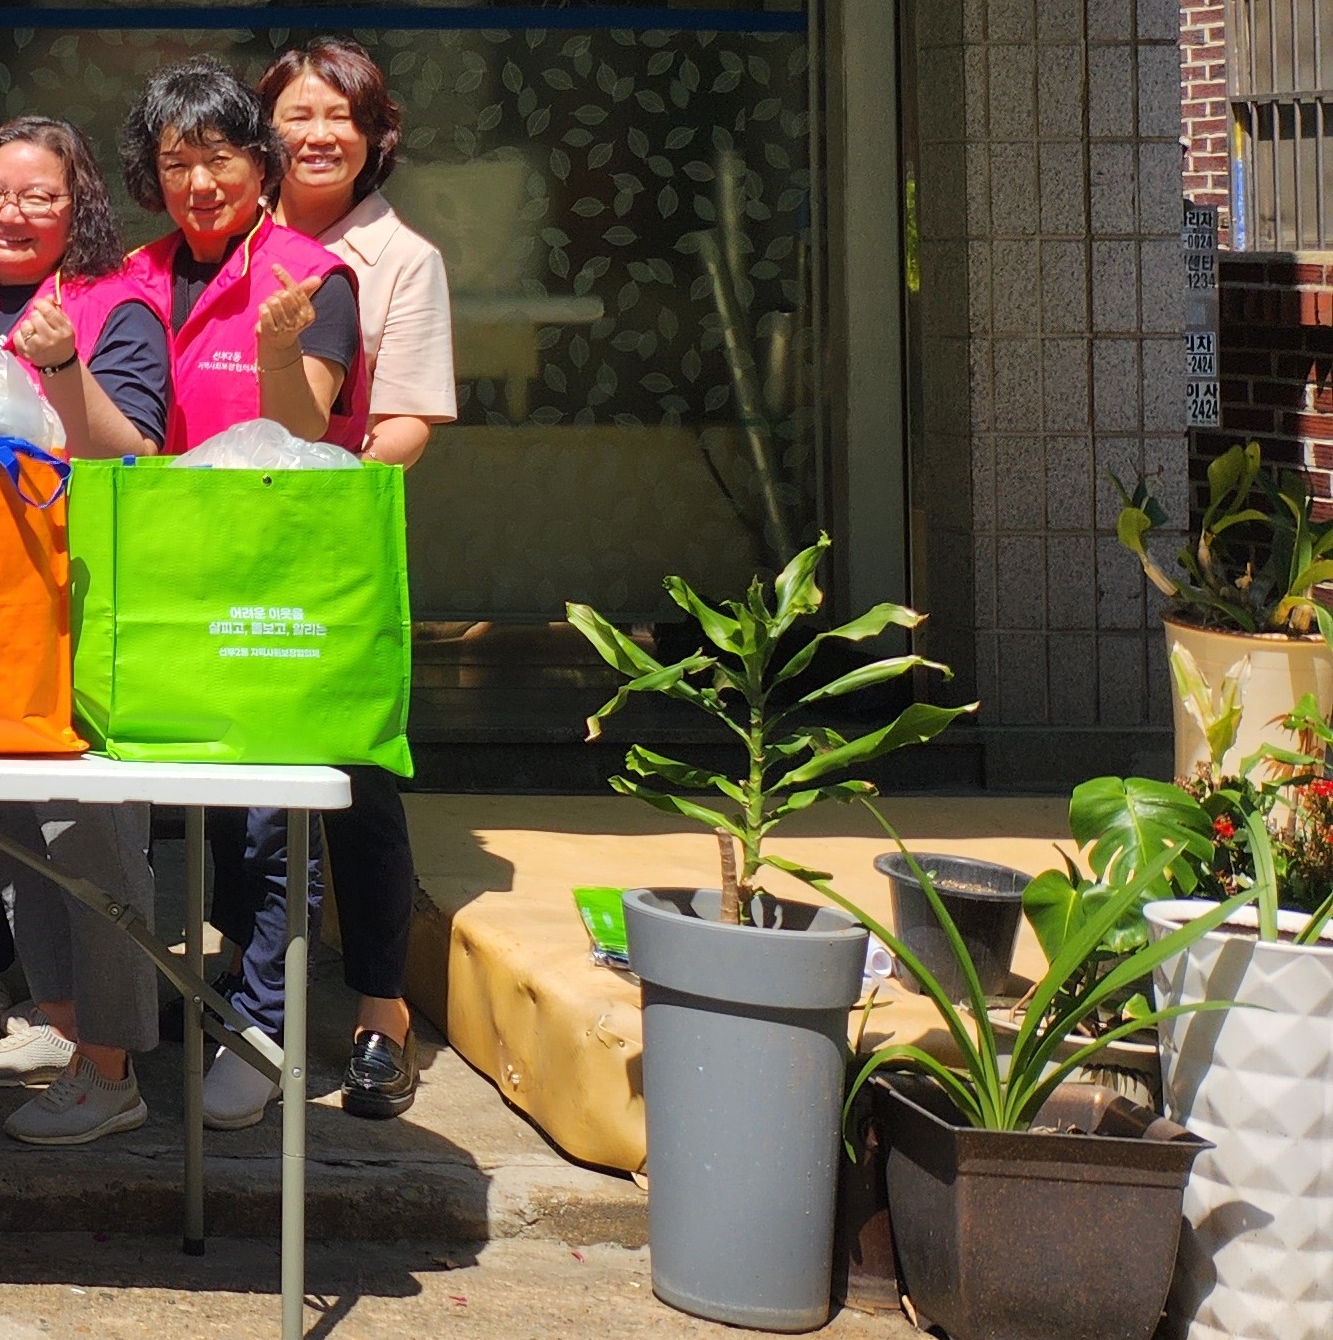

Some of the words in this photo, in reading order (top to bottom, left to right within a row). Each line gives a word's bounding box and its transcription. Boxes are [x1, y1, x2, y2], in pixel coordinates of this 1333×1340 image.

[1184, 255, 1214, 271] 센타
[230, 606, 266, 620] 어려운
[268, 607, 304, 621] 이웃을
[209, 622, 248, 636] 살피고,
[292, 623, 327, 636] 알리는
